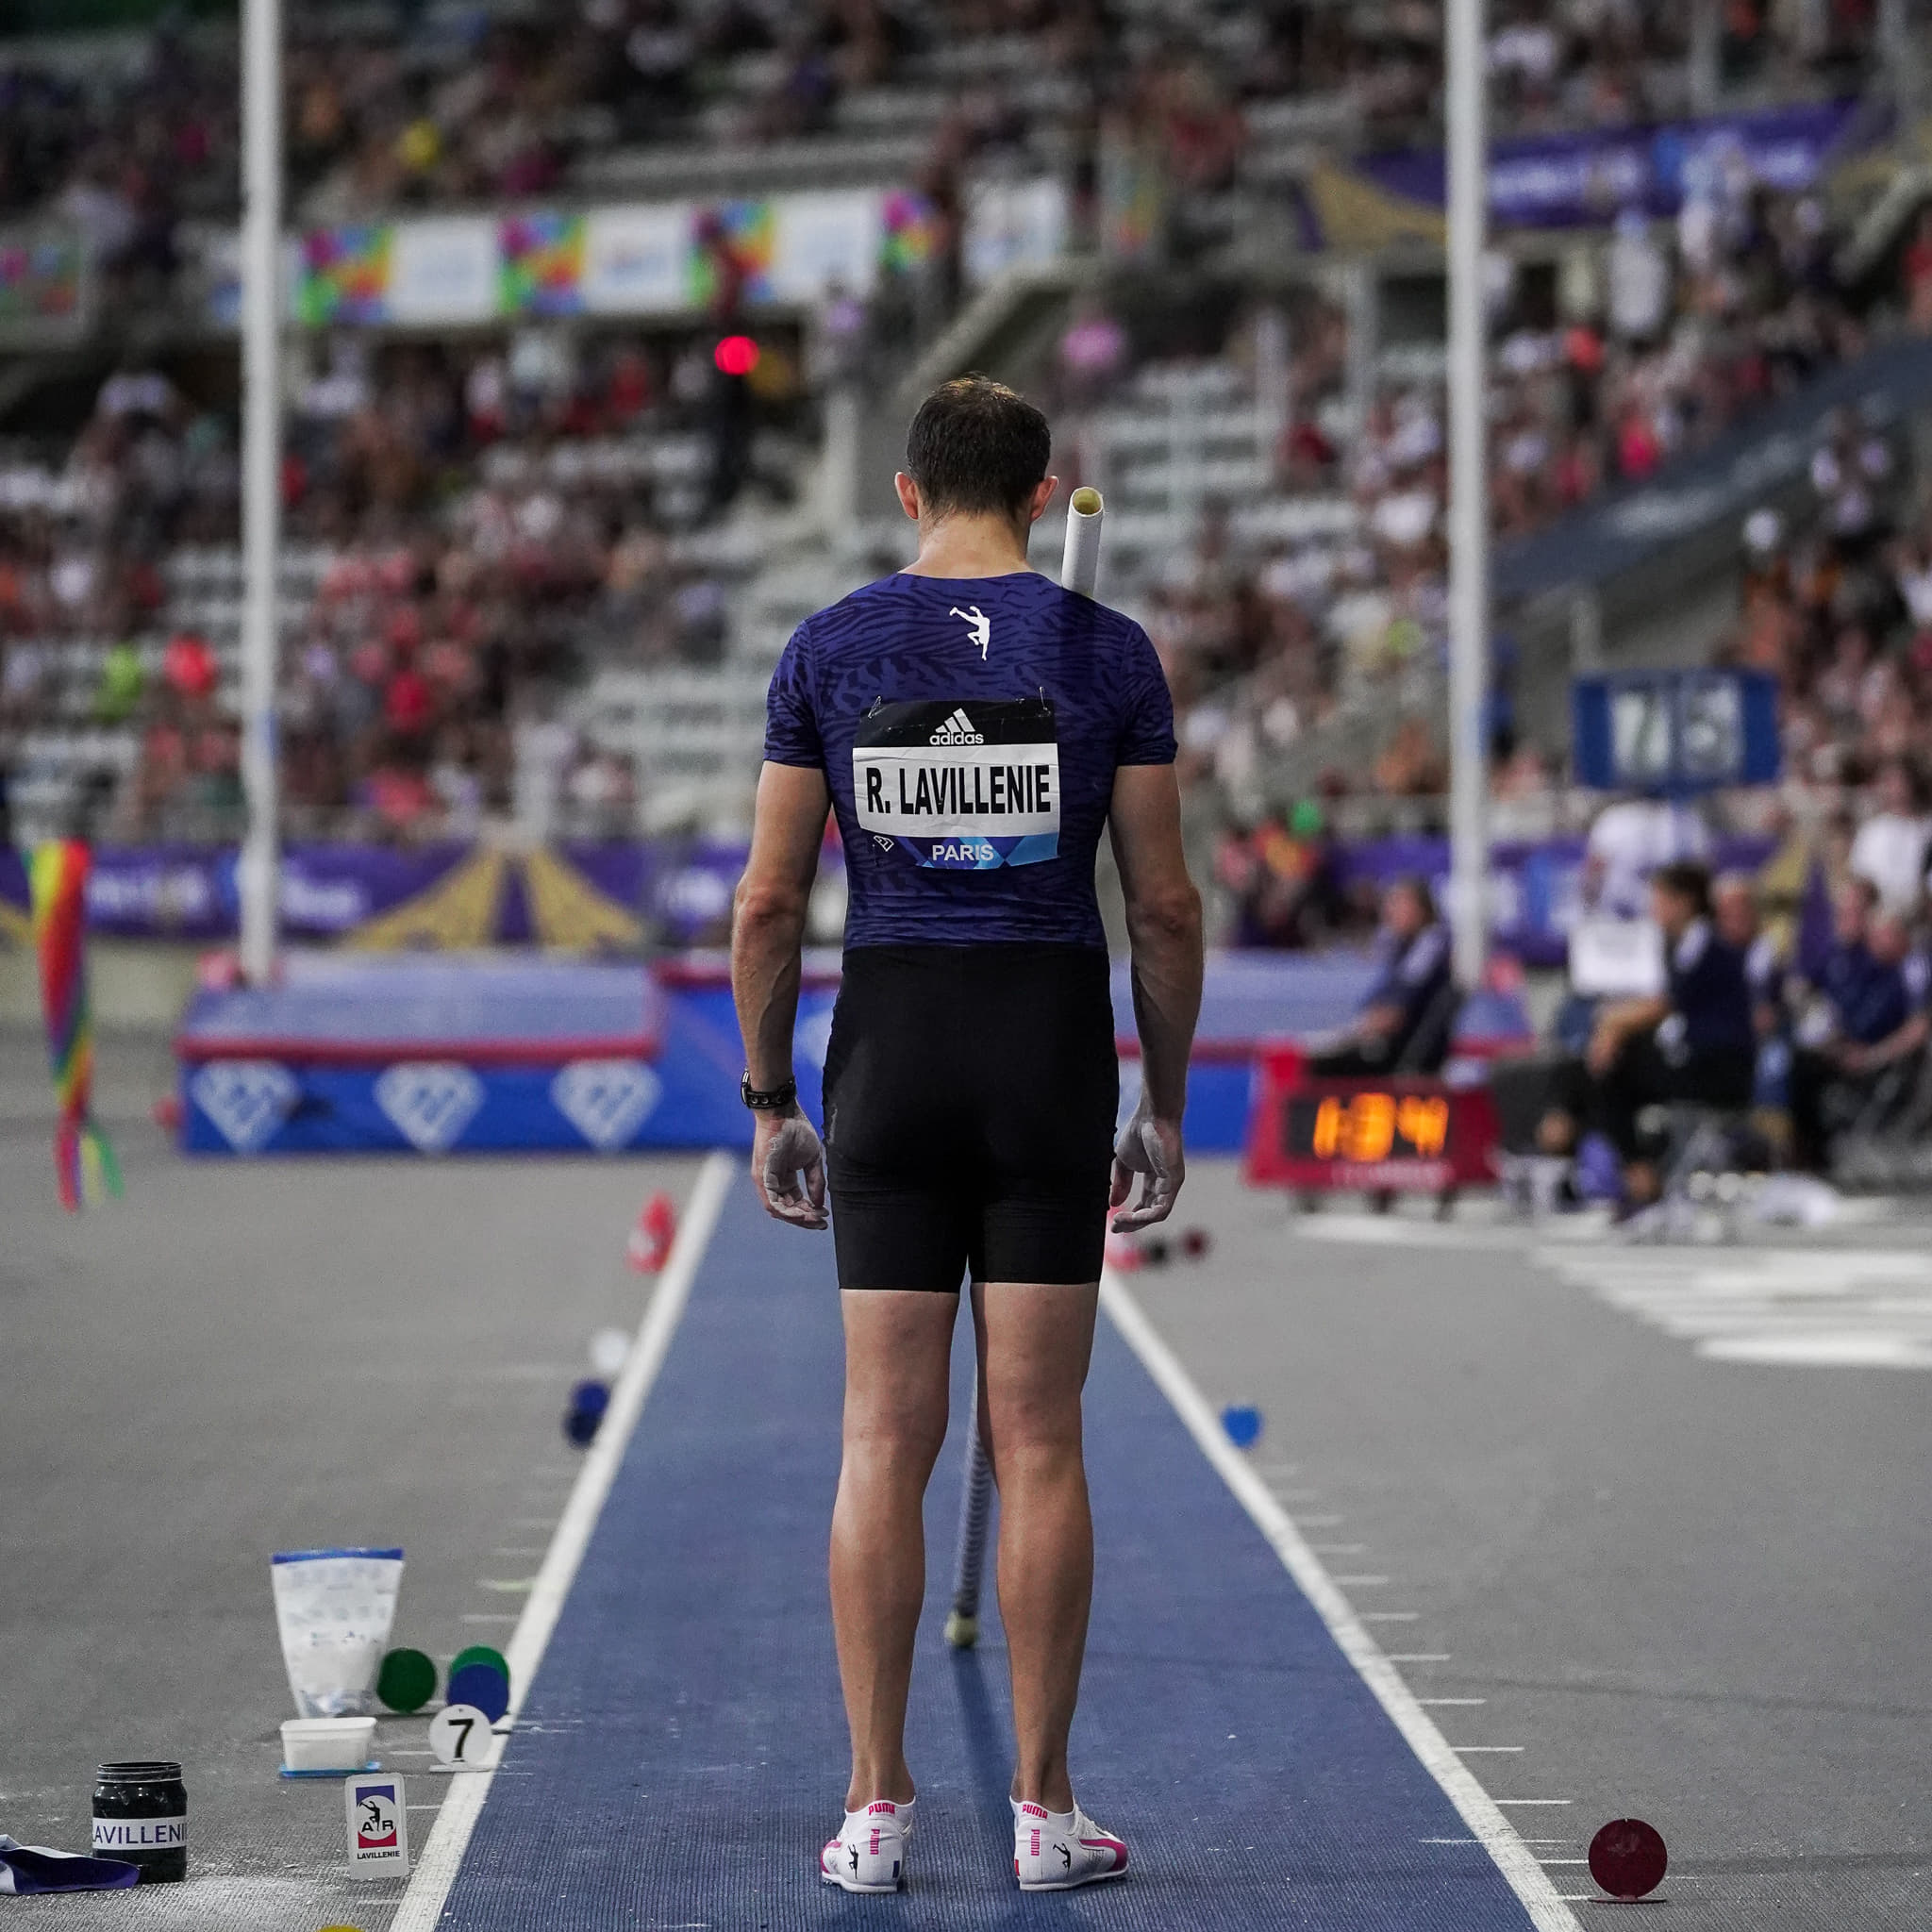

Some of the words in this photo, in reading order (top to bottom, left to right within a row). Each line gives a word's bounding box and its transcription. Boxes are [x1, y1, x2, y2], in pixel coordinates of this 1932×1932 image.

[929, 732, 984, 746] adidas
[866, 767, 891, 814] R.
[899, 765, 1051, 815] LAVILLENIE
[932, 844, 994, 861] PARIS
[447, 1718, 475, 1758] 7
[868, 1803, 895, 1816] PUMA
[1023, 1804, 1048, 1820] PUMA
[870, 1828, 881, 1856] PUMA
[1030, 1828, 1041, 1857] PUMA
[357, 1850, 401, 1860] LAVILLENIE
